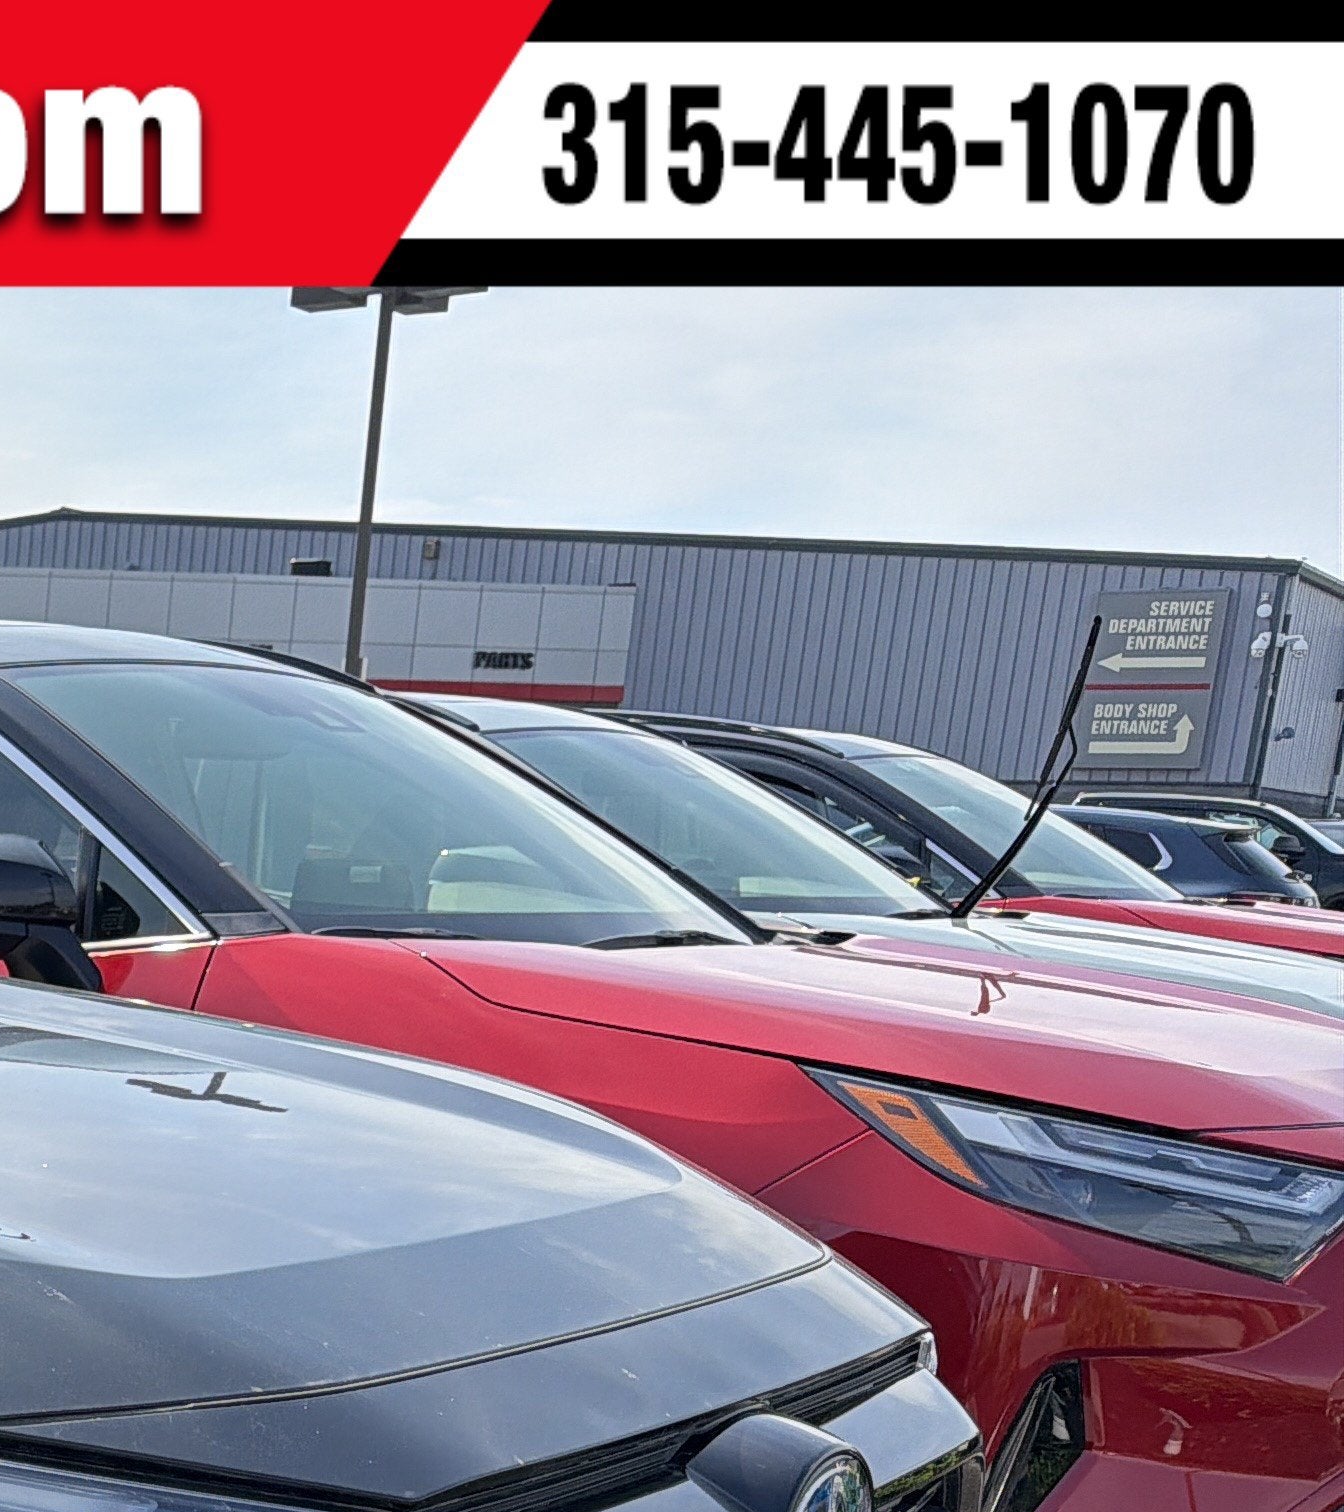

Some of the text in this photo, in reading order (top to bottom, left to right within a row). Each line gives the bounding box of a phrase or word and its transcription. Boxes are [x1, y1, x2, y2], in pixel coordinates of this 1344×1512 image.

[1149, 600, 1215, 617] SERVICE
[1108, 618, 1213, 634] DEPARTMENT
[1125, 635, 1209, 651] ENTRANCE
[473, 651, 535, 670] PARTS
[1093, 703, 1178, 718] BODY SHOP
[1091, 720, 1169, 735] ENTRANCE
